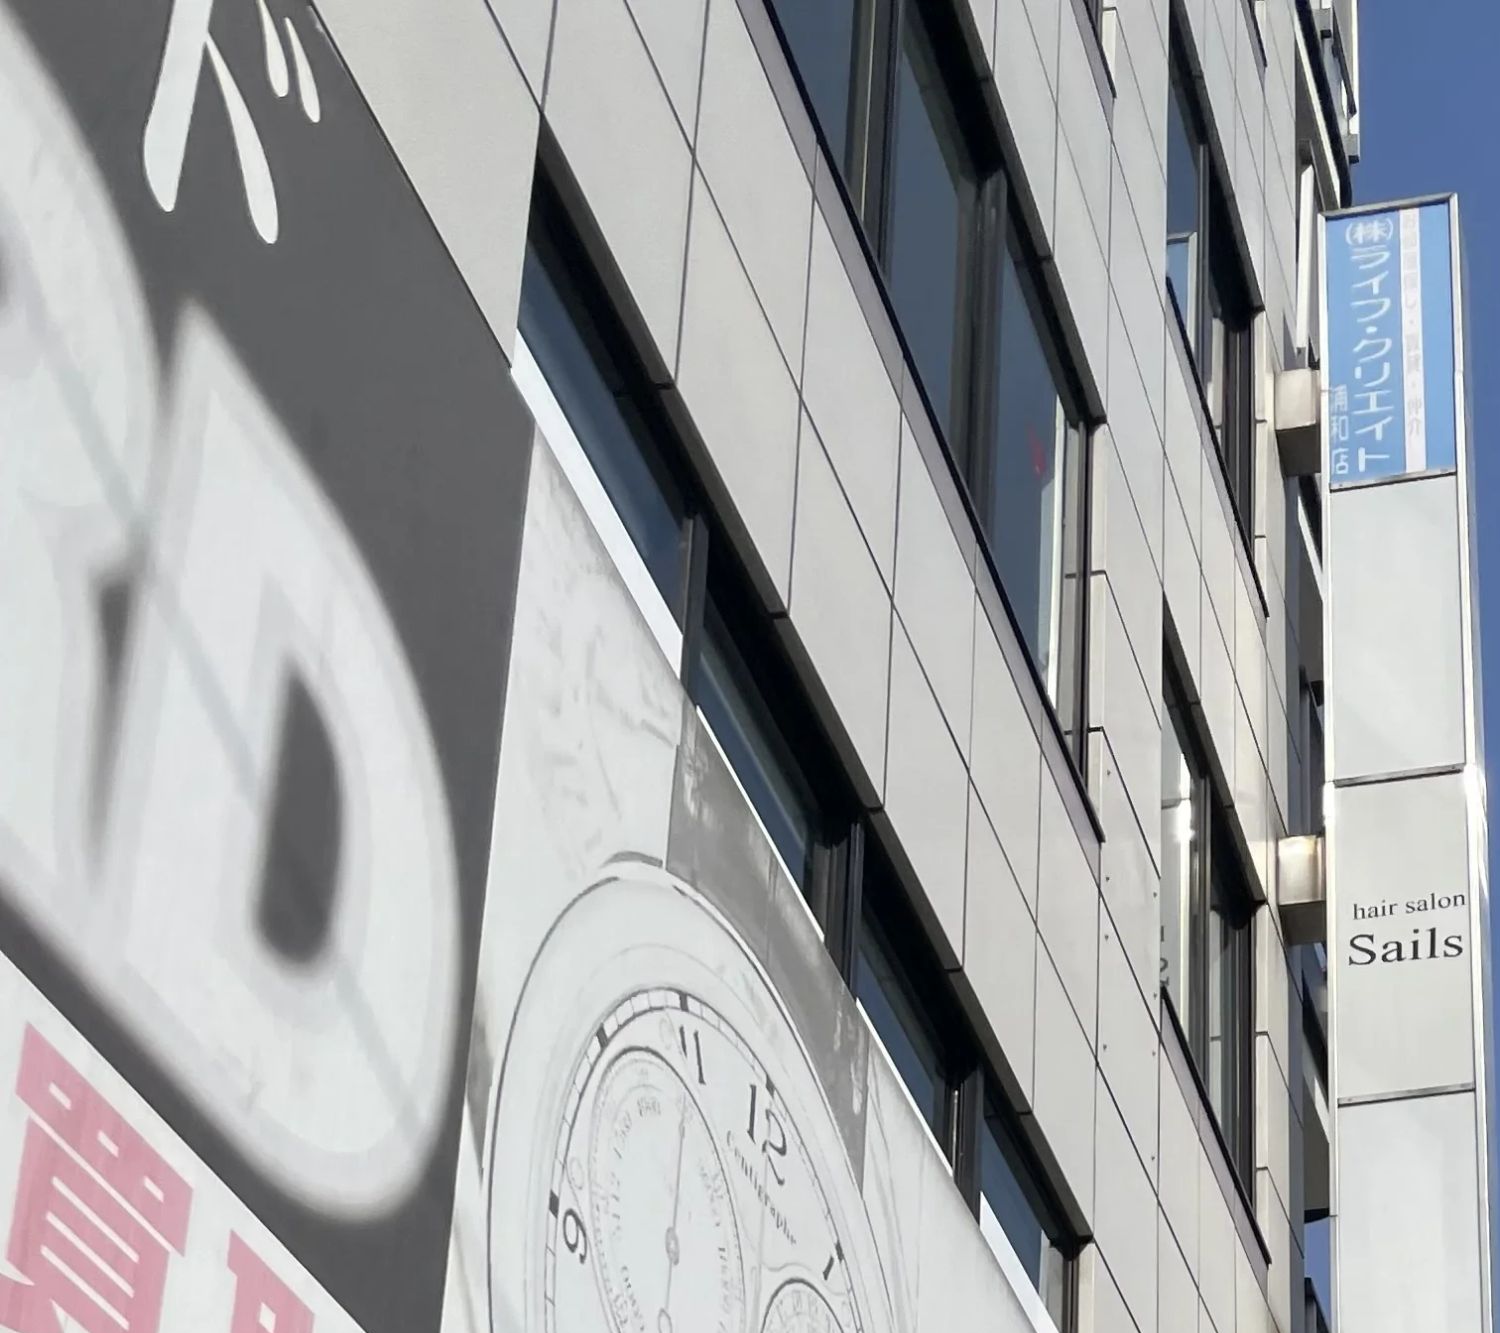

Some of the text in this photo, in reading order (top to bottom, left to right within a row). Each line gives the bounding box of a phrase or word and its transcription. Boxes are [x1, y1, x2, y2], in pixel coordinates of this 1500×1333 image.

[1353, 892, 1466, 920] hair salon
[1348, 927, 1463, 967] Sails
[747, 1083, 788, 1186] 12
